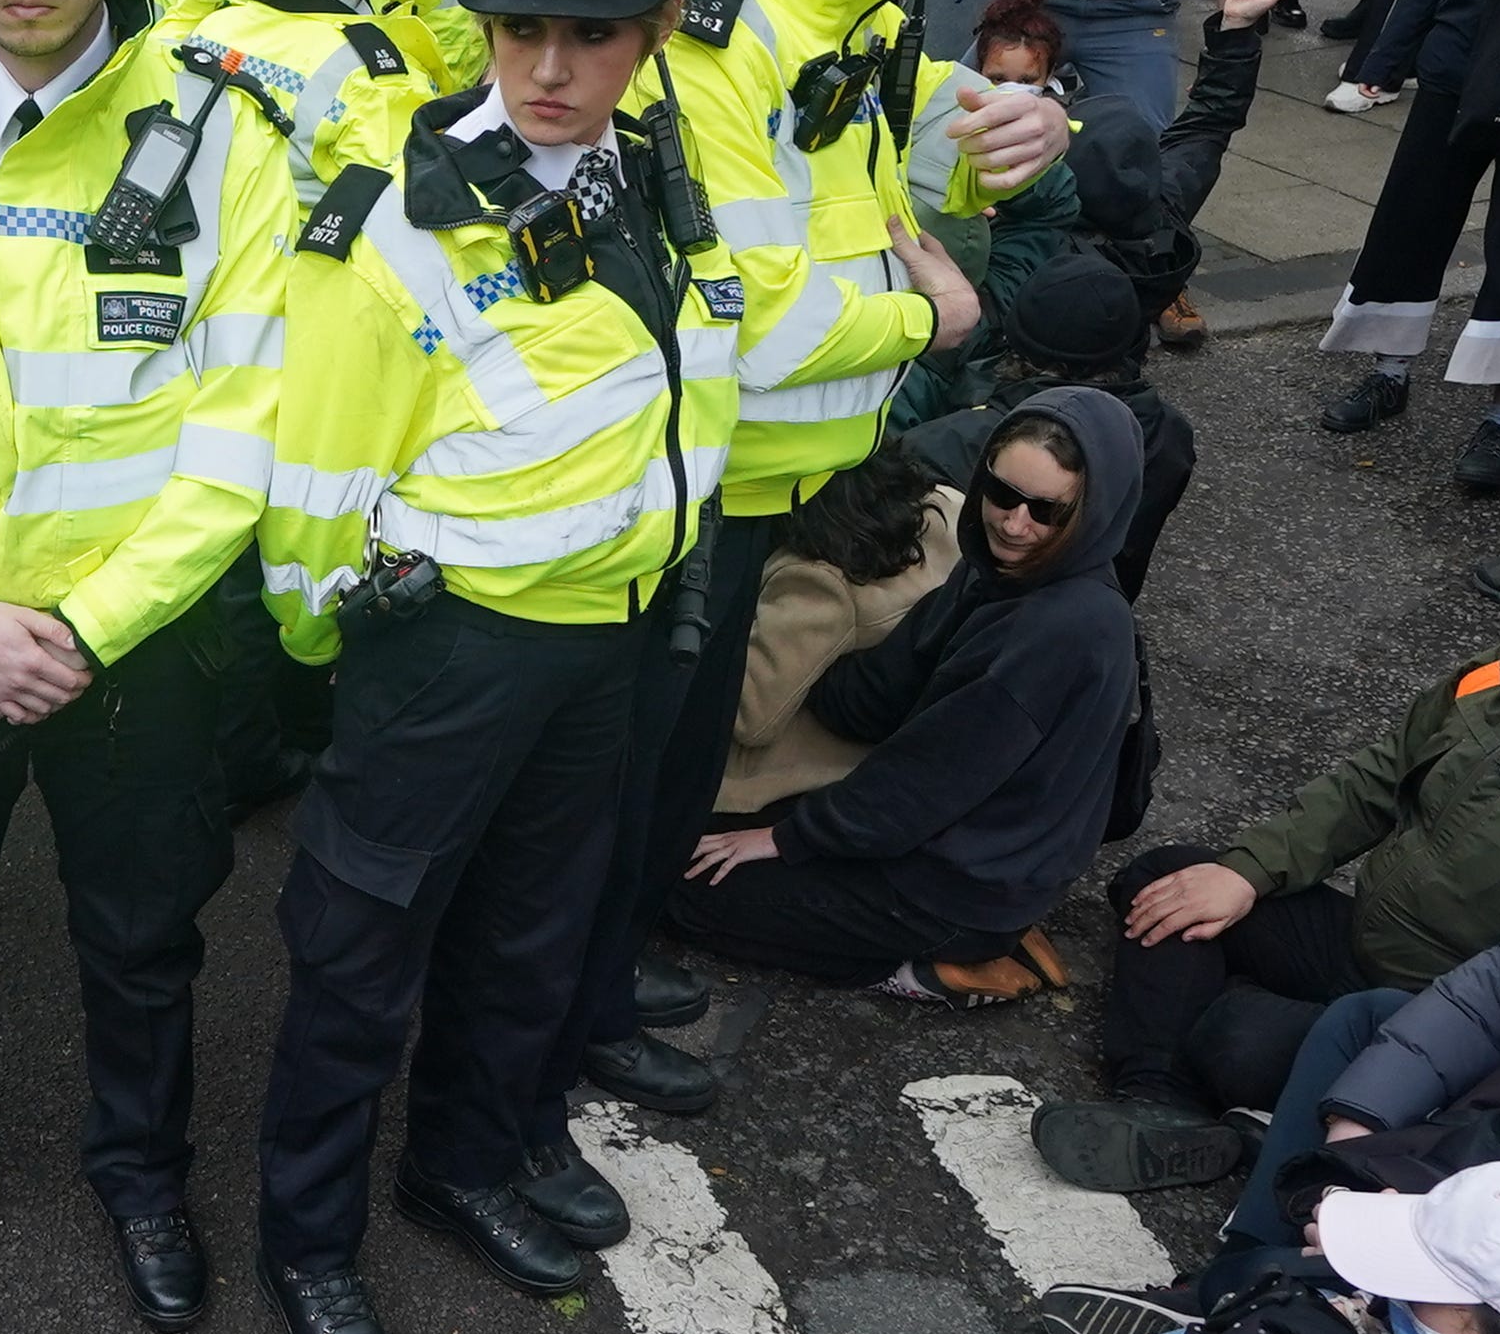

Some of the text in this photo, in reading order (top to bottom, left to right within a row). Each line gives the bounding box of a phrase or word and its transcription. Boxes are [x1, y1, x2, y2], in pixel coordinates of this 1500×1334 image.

[321, 213, 343, 228] AS
[308, 226, 340, 245] 2672
[139, 307, 172, 320] POLICE
[103, 323, 177, 338] POLICE OFFICER
